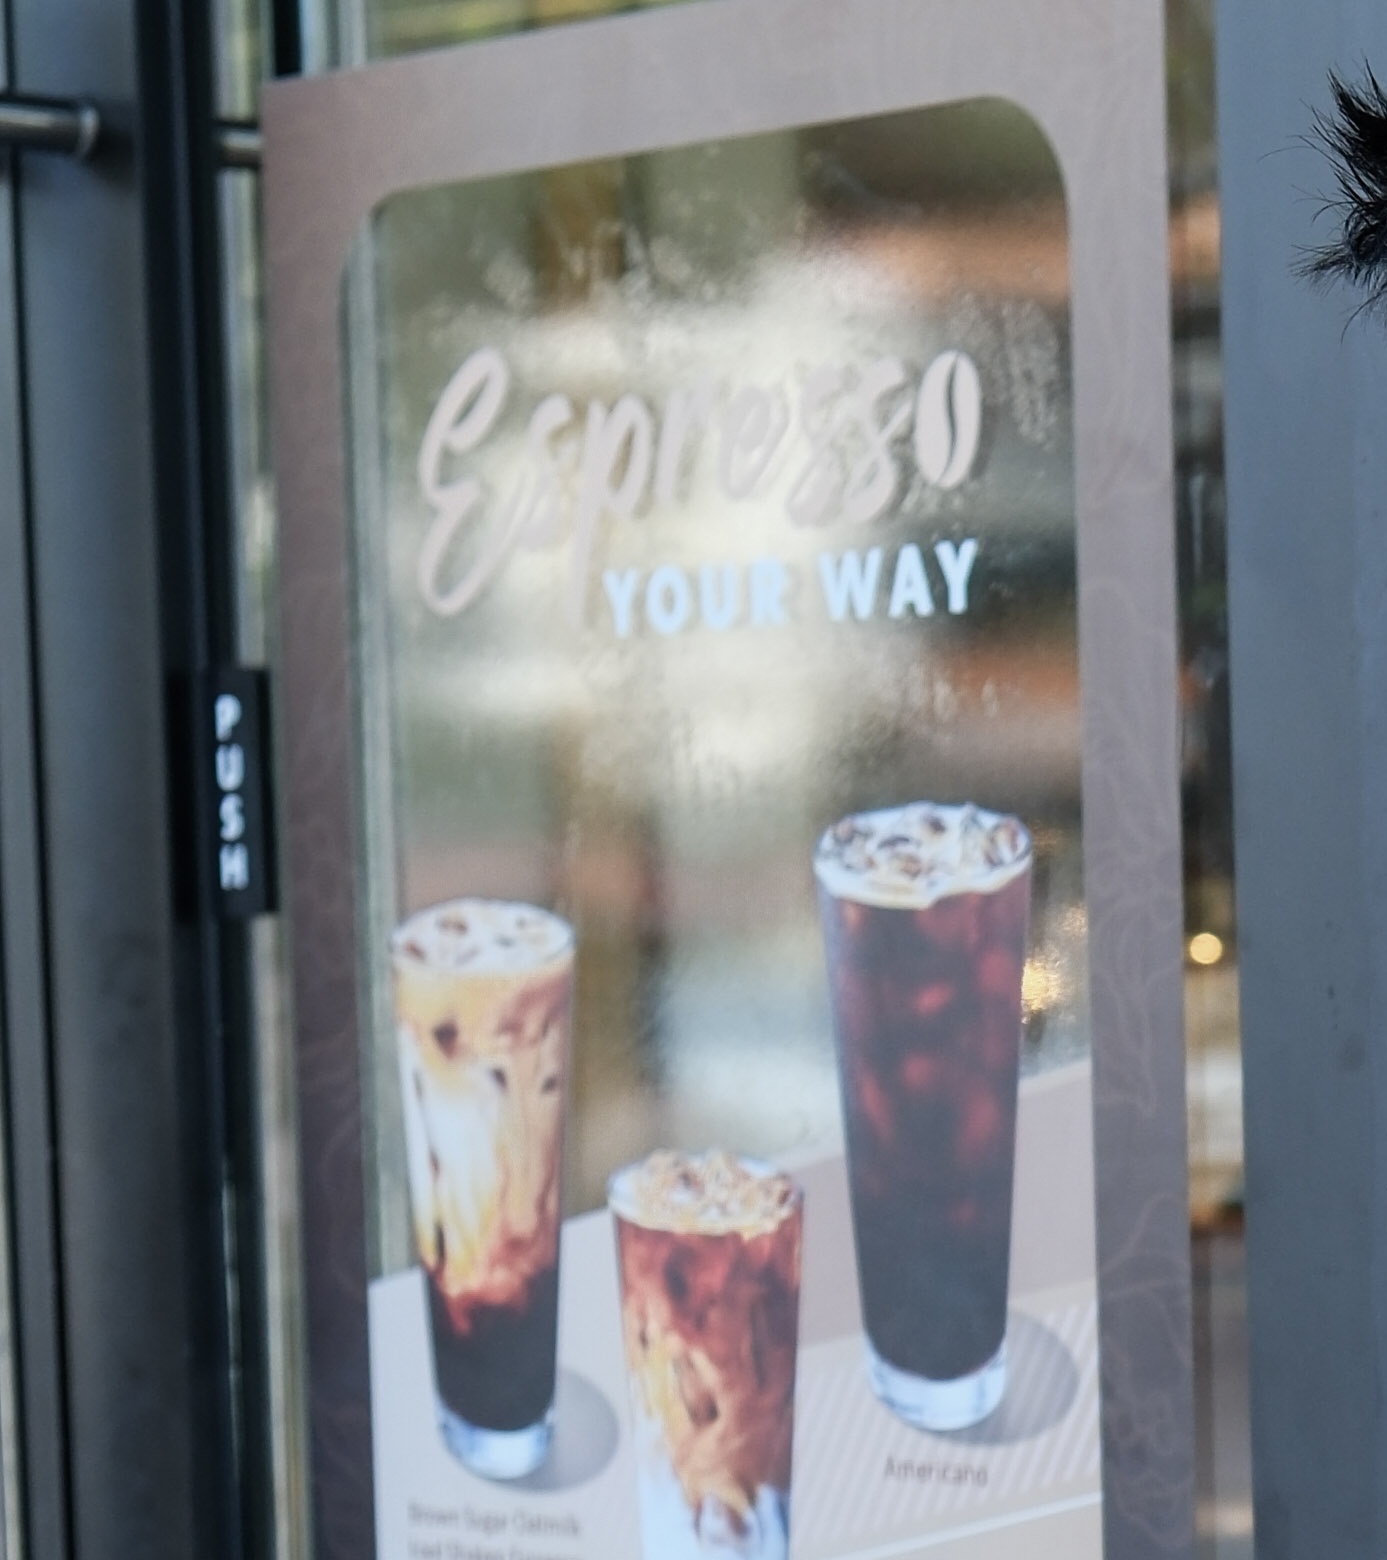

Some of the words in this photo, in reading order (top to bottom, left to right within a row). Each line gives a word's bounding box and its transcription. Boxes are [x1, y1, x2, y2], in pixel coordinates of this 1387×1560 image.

[604, 553, 789, 638] YOUR
[817, 537, 979, 624] WAY
[214, 693, 249, 890] PUSH
